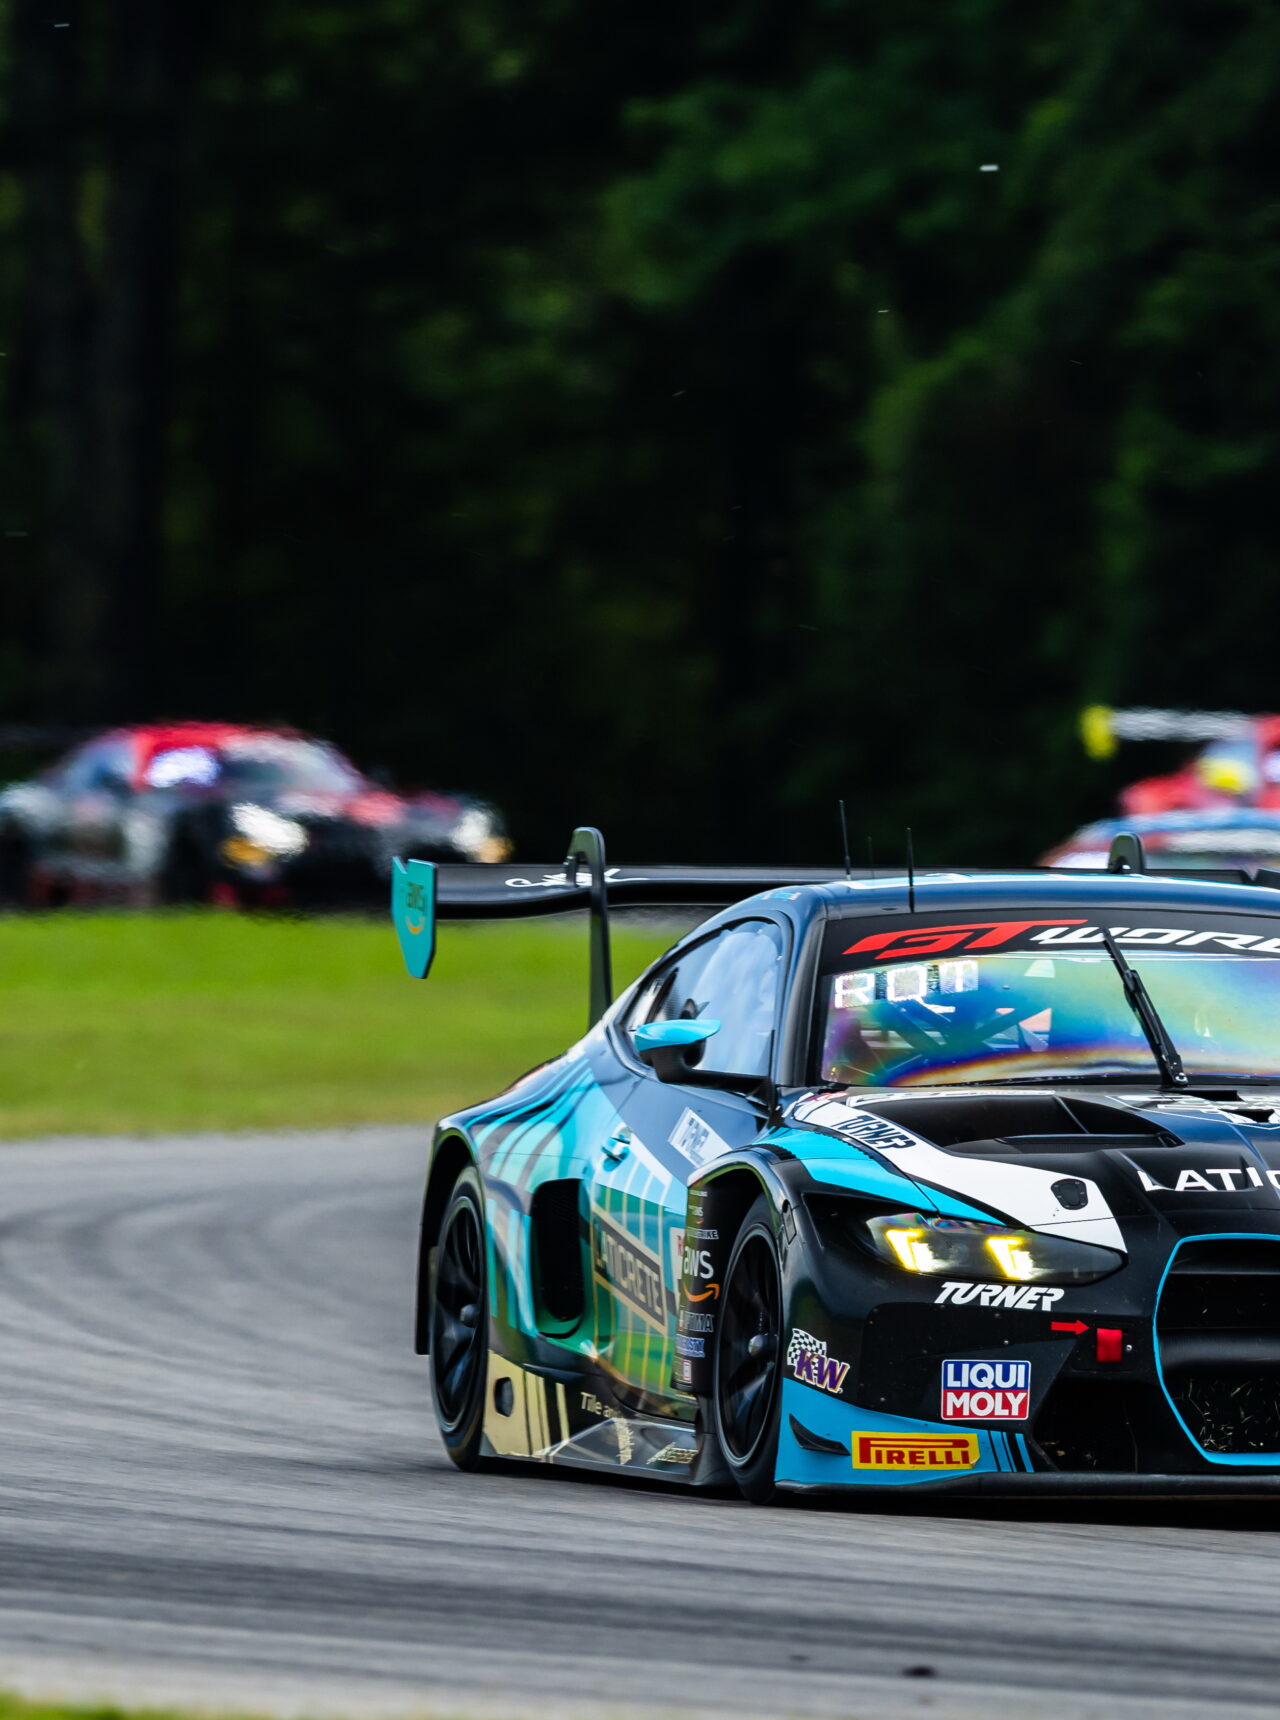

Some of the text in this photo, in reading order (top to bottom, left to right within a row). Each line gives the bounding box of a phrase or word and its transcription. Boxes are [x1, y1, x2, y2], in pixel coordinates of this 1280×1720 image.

[842, 918, 1089, 960] GT
[933, 1281, 1065, 1312] TURNER
[793, 1349, 851, 1394] KW
[946, 1362, 1027, 1390] LIQUI
[945, 1391, 1028, 1417] MOLY
[858, 1436, 971, 1465] PIRELLI
